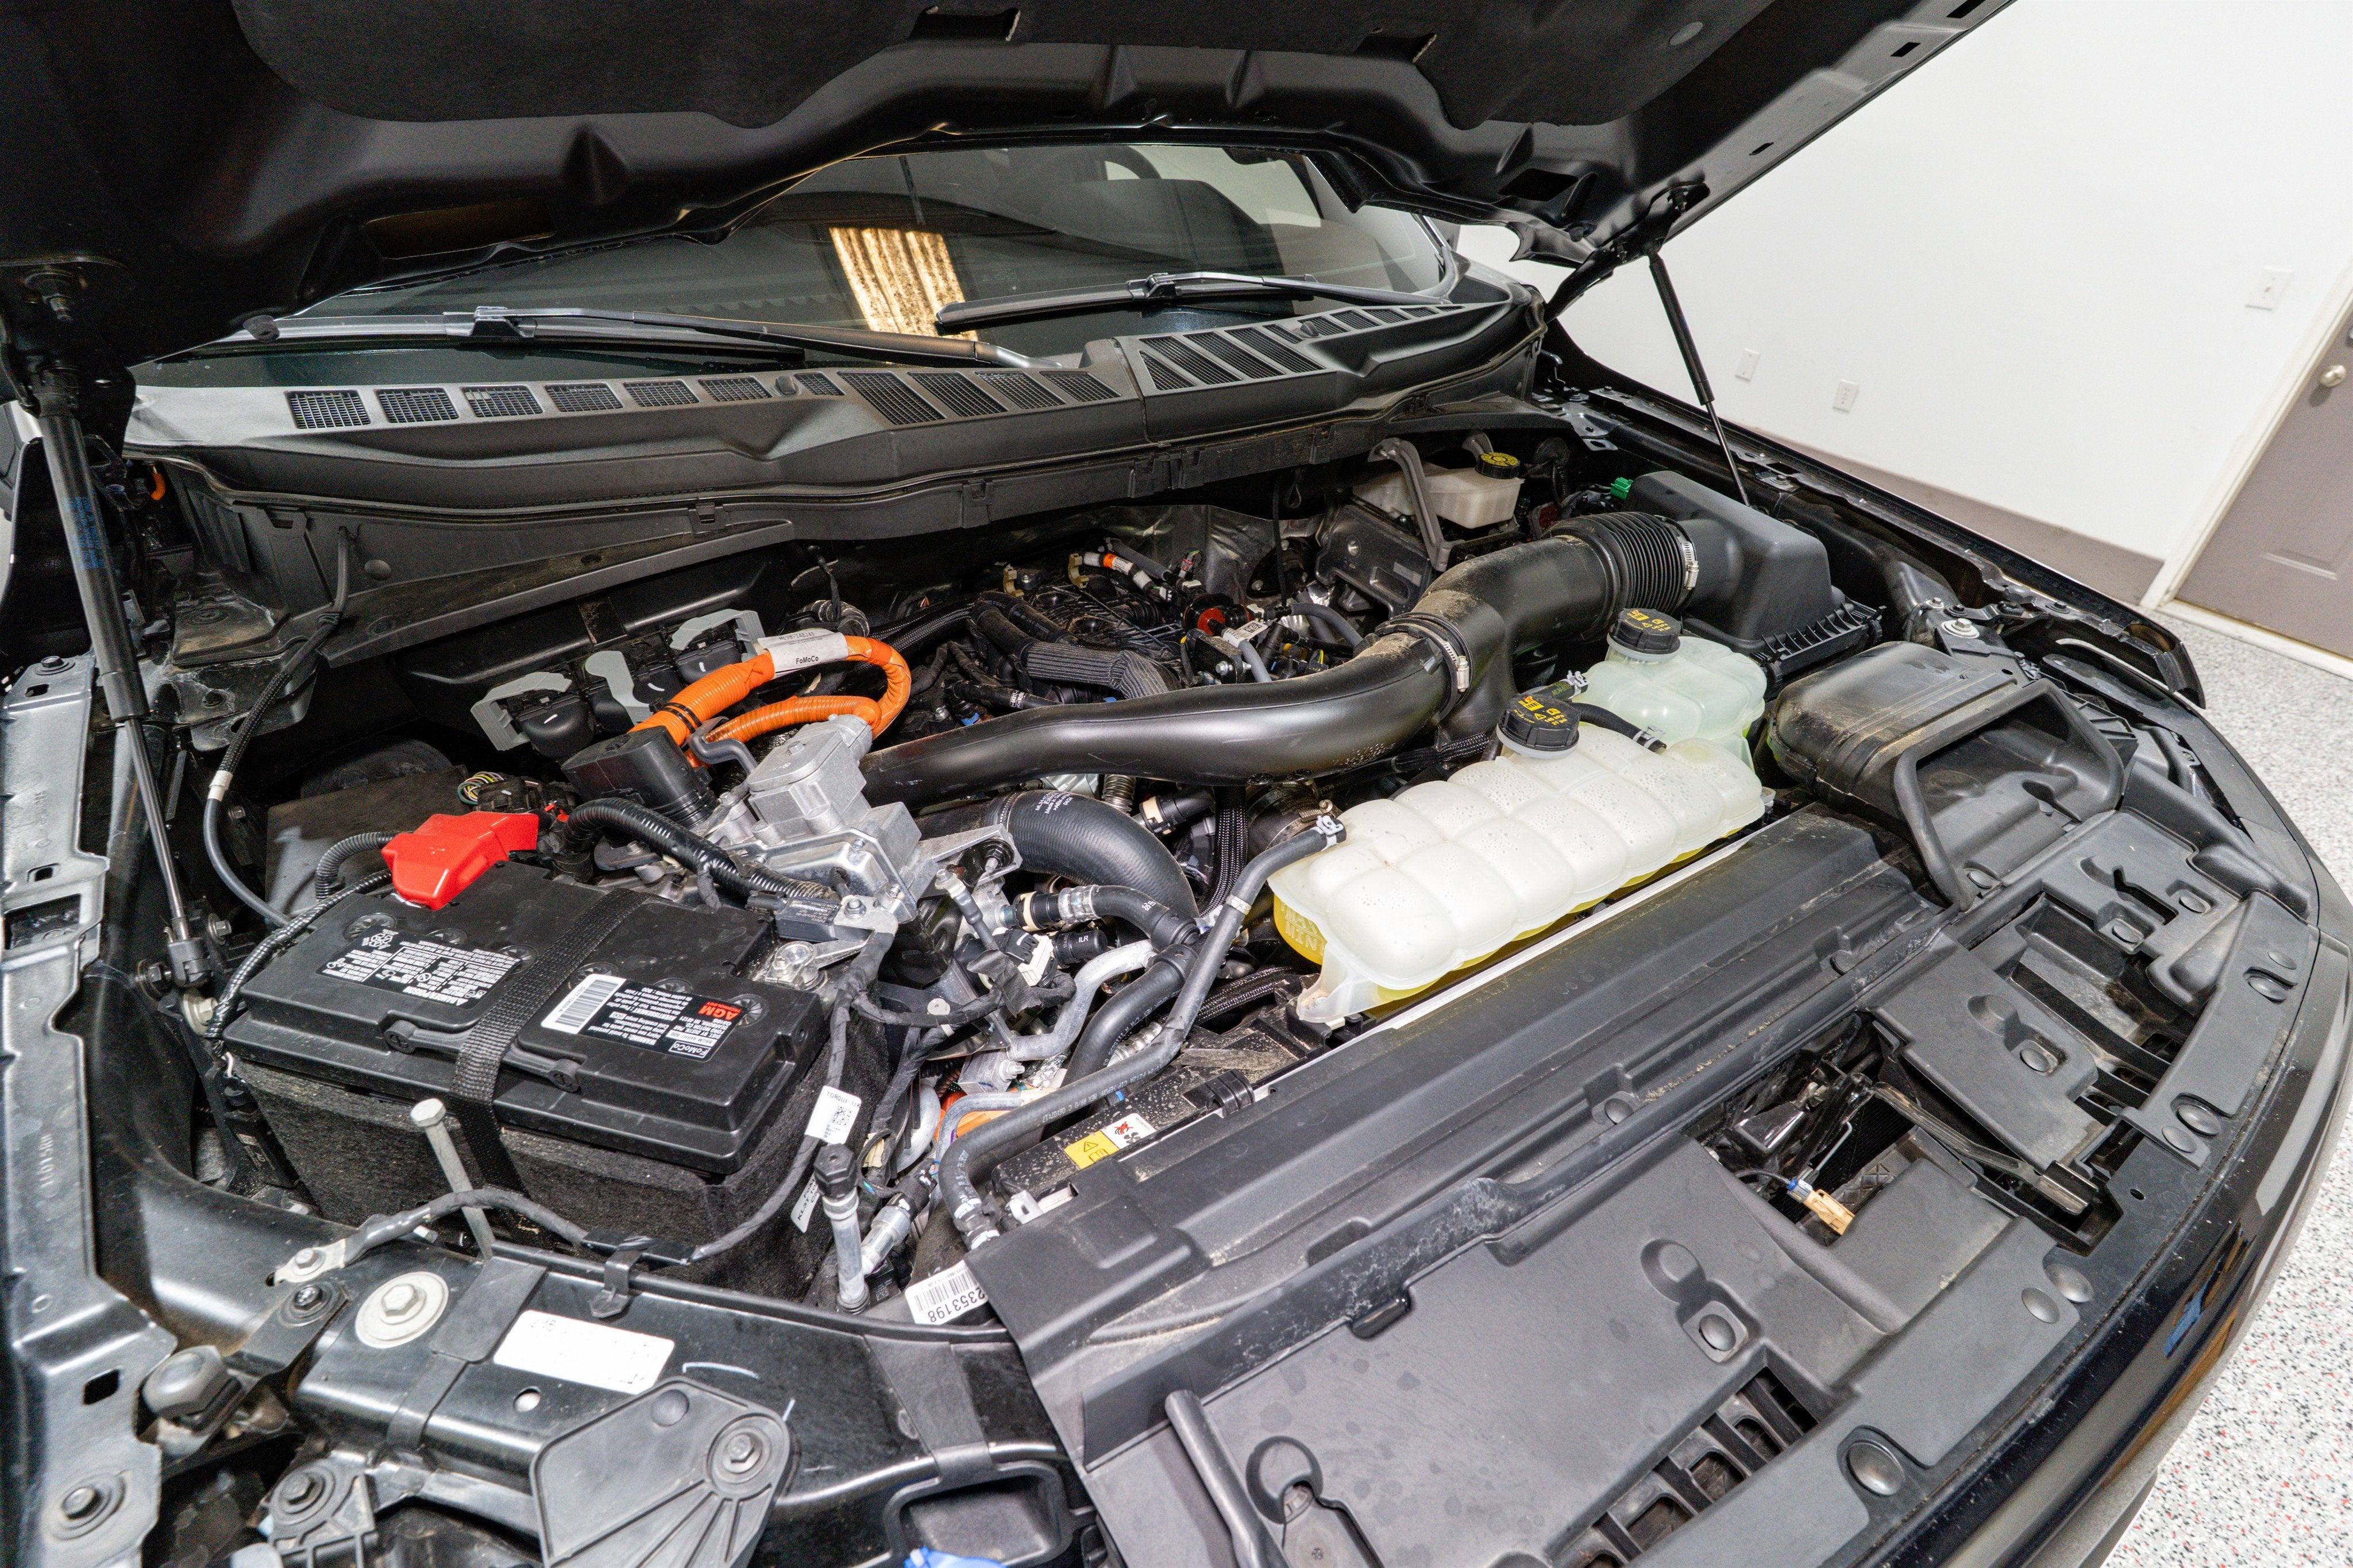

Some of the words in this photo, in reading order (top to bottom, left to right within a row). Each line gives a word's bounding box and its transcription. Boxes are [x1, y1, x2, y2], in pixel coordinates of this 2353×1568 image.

[796, 655, 819, 665] FoMoCo
[1285, 921, 1317, 951] MIN
[699, 1005, 740, 1021] AGM
[706, 1002, 741, 1012] TECHNOLOGY
[628, 1034, 656, 1045] WARNING:
[674, 1043, 708, 1056] FoMoCo
[927, 1287, 988, 1322] 2353198
